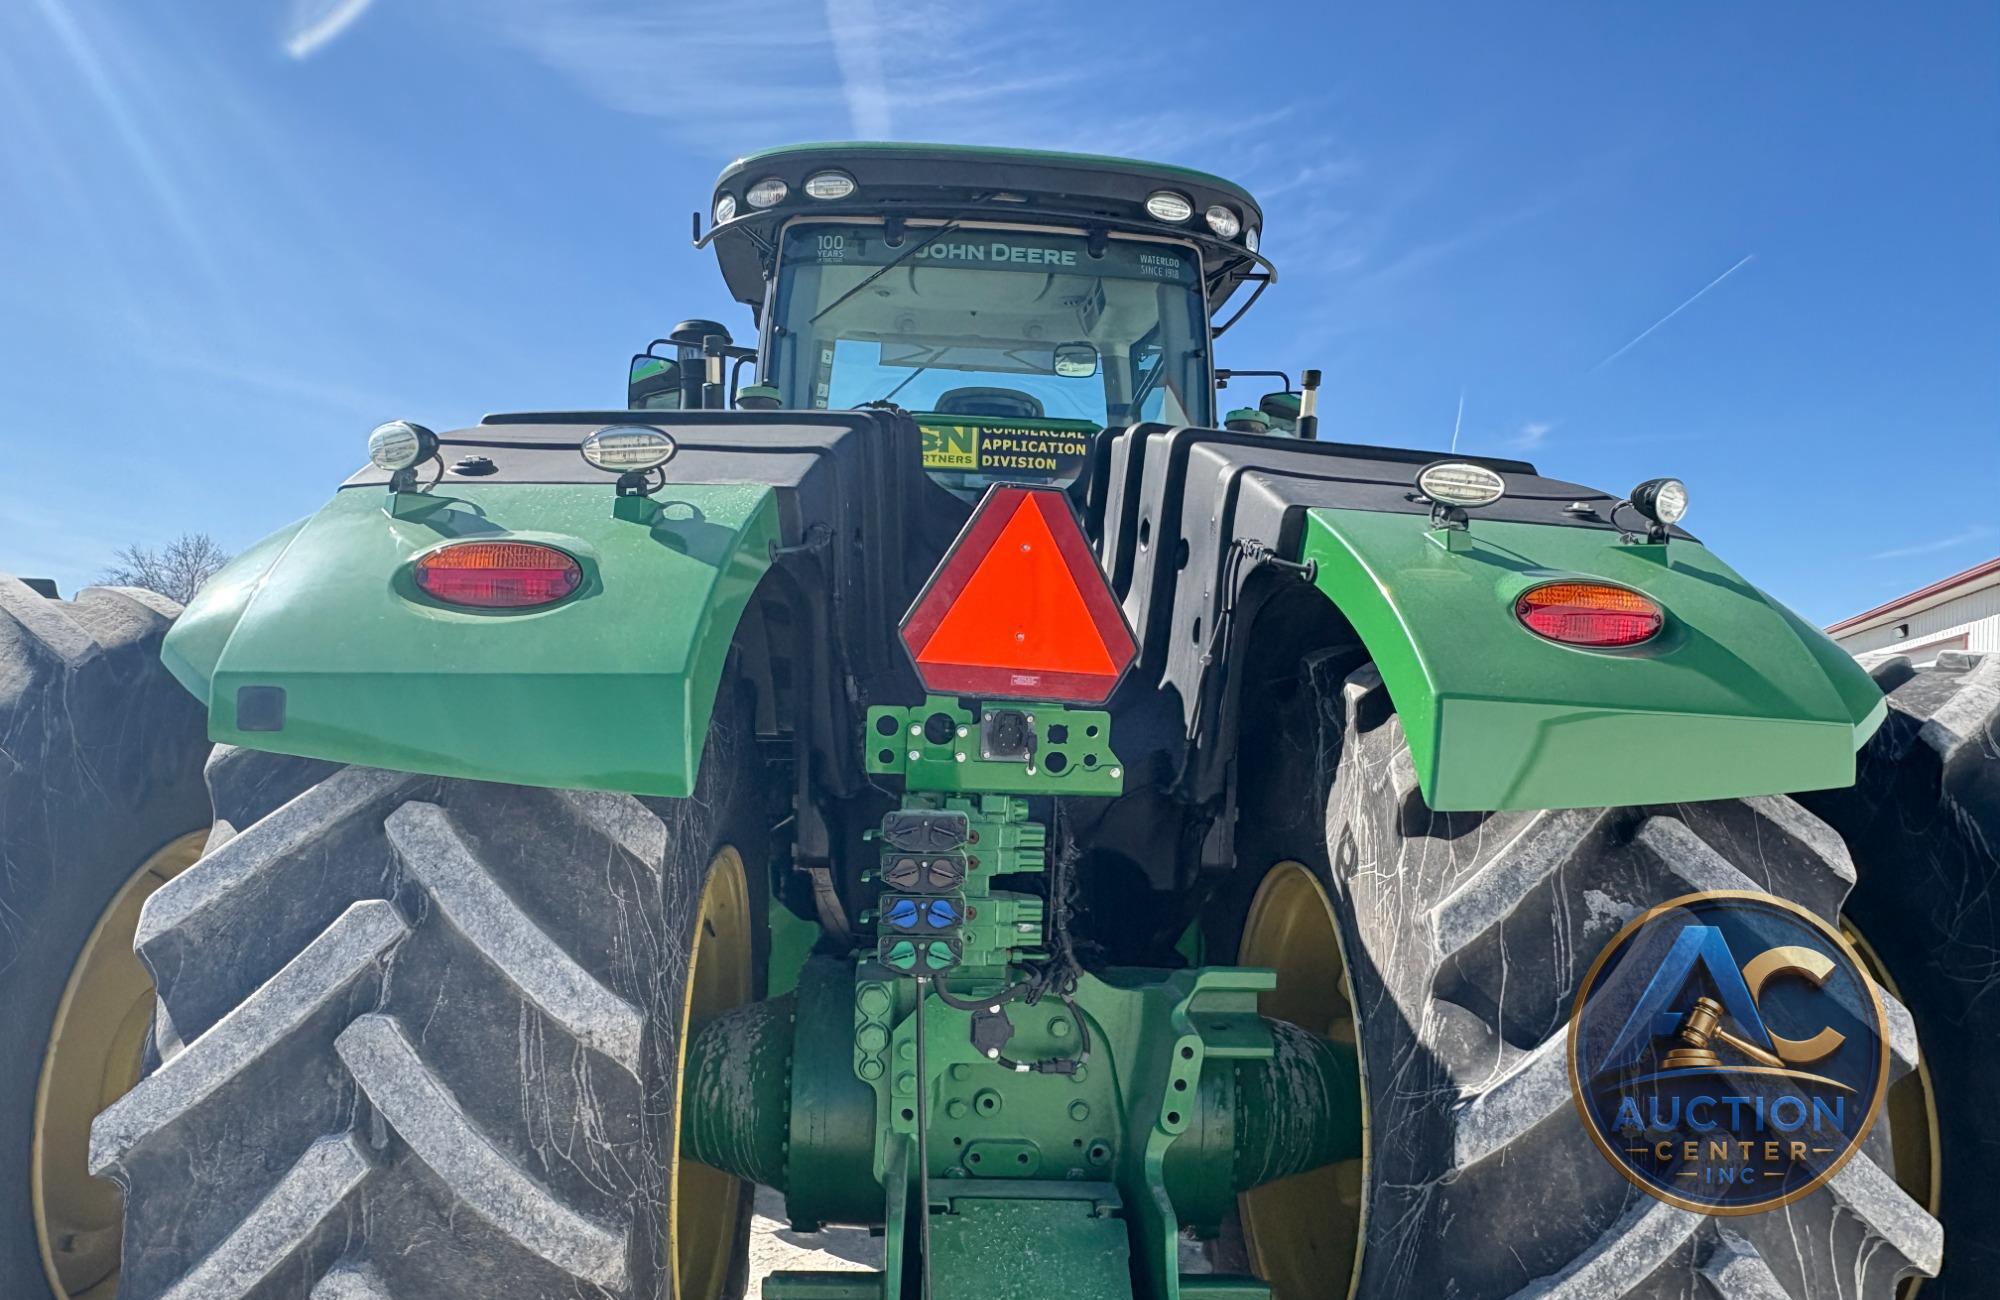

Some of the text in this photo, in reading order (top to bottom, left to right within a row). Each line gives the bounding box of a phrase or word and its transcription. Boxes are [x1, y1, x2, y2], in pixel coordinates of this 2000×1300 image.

[817, 235, 844, 250] 100
[817, 249, 844, 258] YEARS
[915, 243, 1076, 266] JOHN DEERE
[1140, 254, 1180, 268] WATERLOO
[1141, 264, 1163, 277] SINCE
[982, 438, 1086, 456] APPLICATION
[982, 455, 1057, 470] DIVISION
